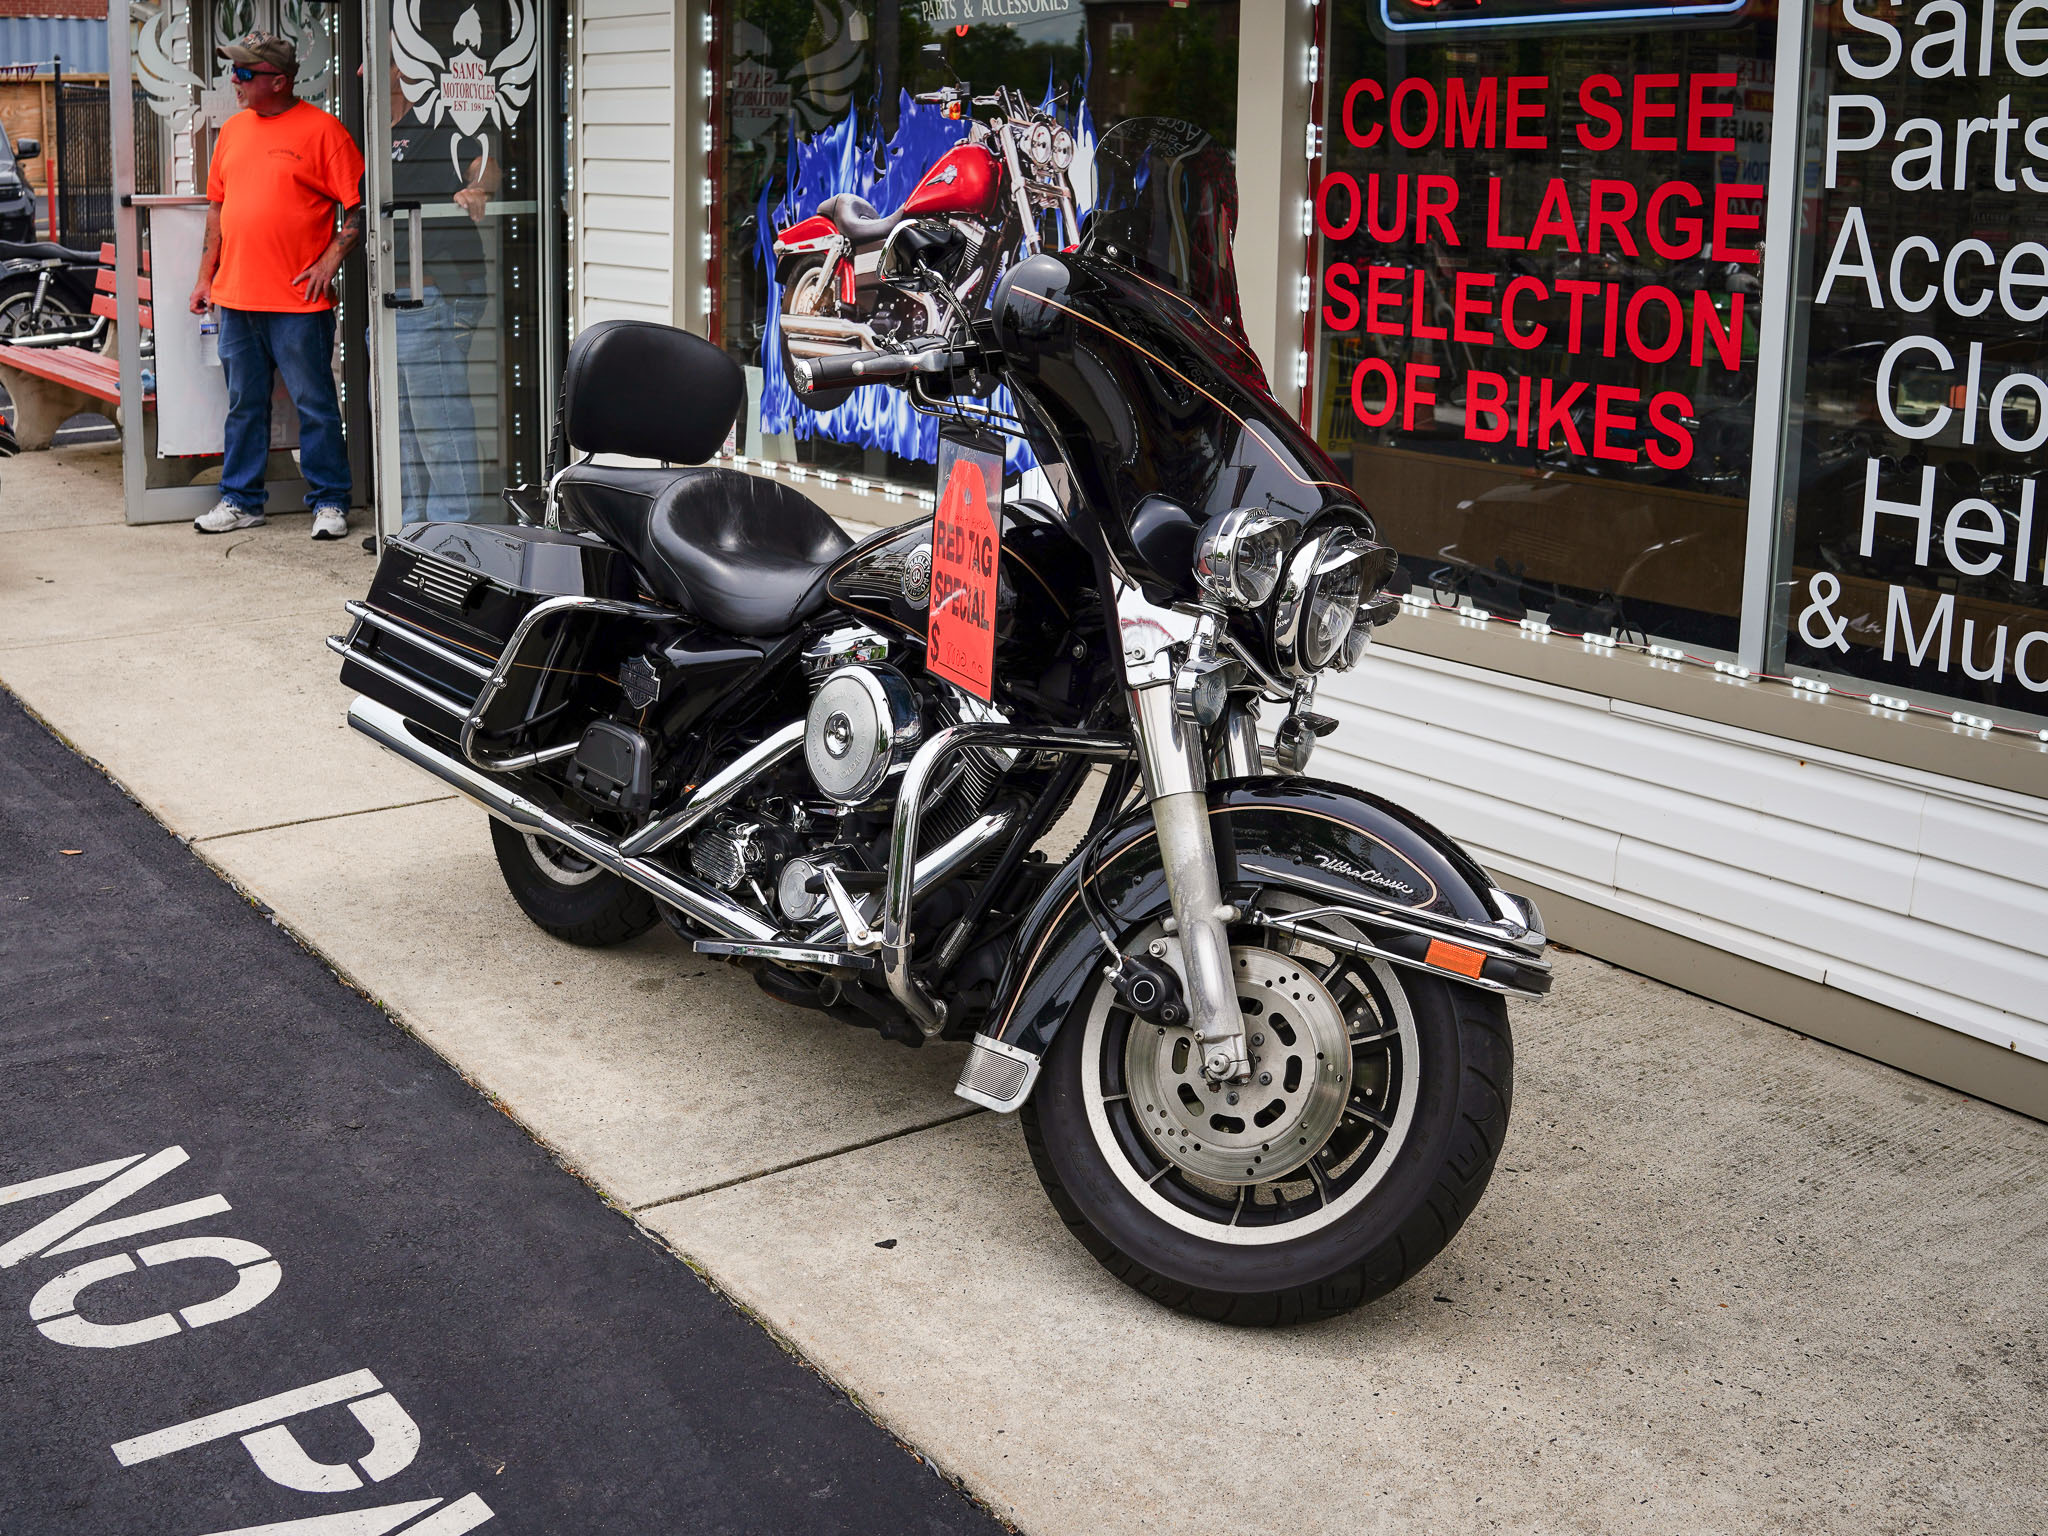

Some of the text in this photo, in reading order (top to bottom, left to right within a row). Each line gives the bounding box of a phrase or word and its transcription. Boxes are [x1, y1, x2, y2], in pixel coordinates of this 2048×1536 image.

[921, 0, 957, 21] PARTS
[963, 0, 974, 18] &
[1837, 0, 2048, 80] Sale
[442, 82, 495, 100] MOTORCYCLES
[452, 62, 484, 81] SAM'S
[453, 100, 470, 112] EST.
[1342, 73, 1738, 152] COME SEE
[1825, 93, 2048, 193] Parts
[1316, 172, 1764, 264] OUR LARGE
[1814, 206, 2048, 321] Acce
[1322, 262, 1745, 371] SELECTION
[1351, 357, 1441, 432] OF
[1464, 369, 1694, 470] BIKES
[1876, 335, 2048, 452] Clo
[935, 519, 993, 578] RED TAG
[1859, 458, 2048, 586] Hel
[934, 570, 990, 631] SPECIAL
[1798, 571, 1850, 654] &
[1315, 854, 1414, 894] Ultra Classic
[0, 1145, 282, 1348] NO
